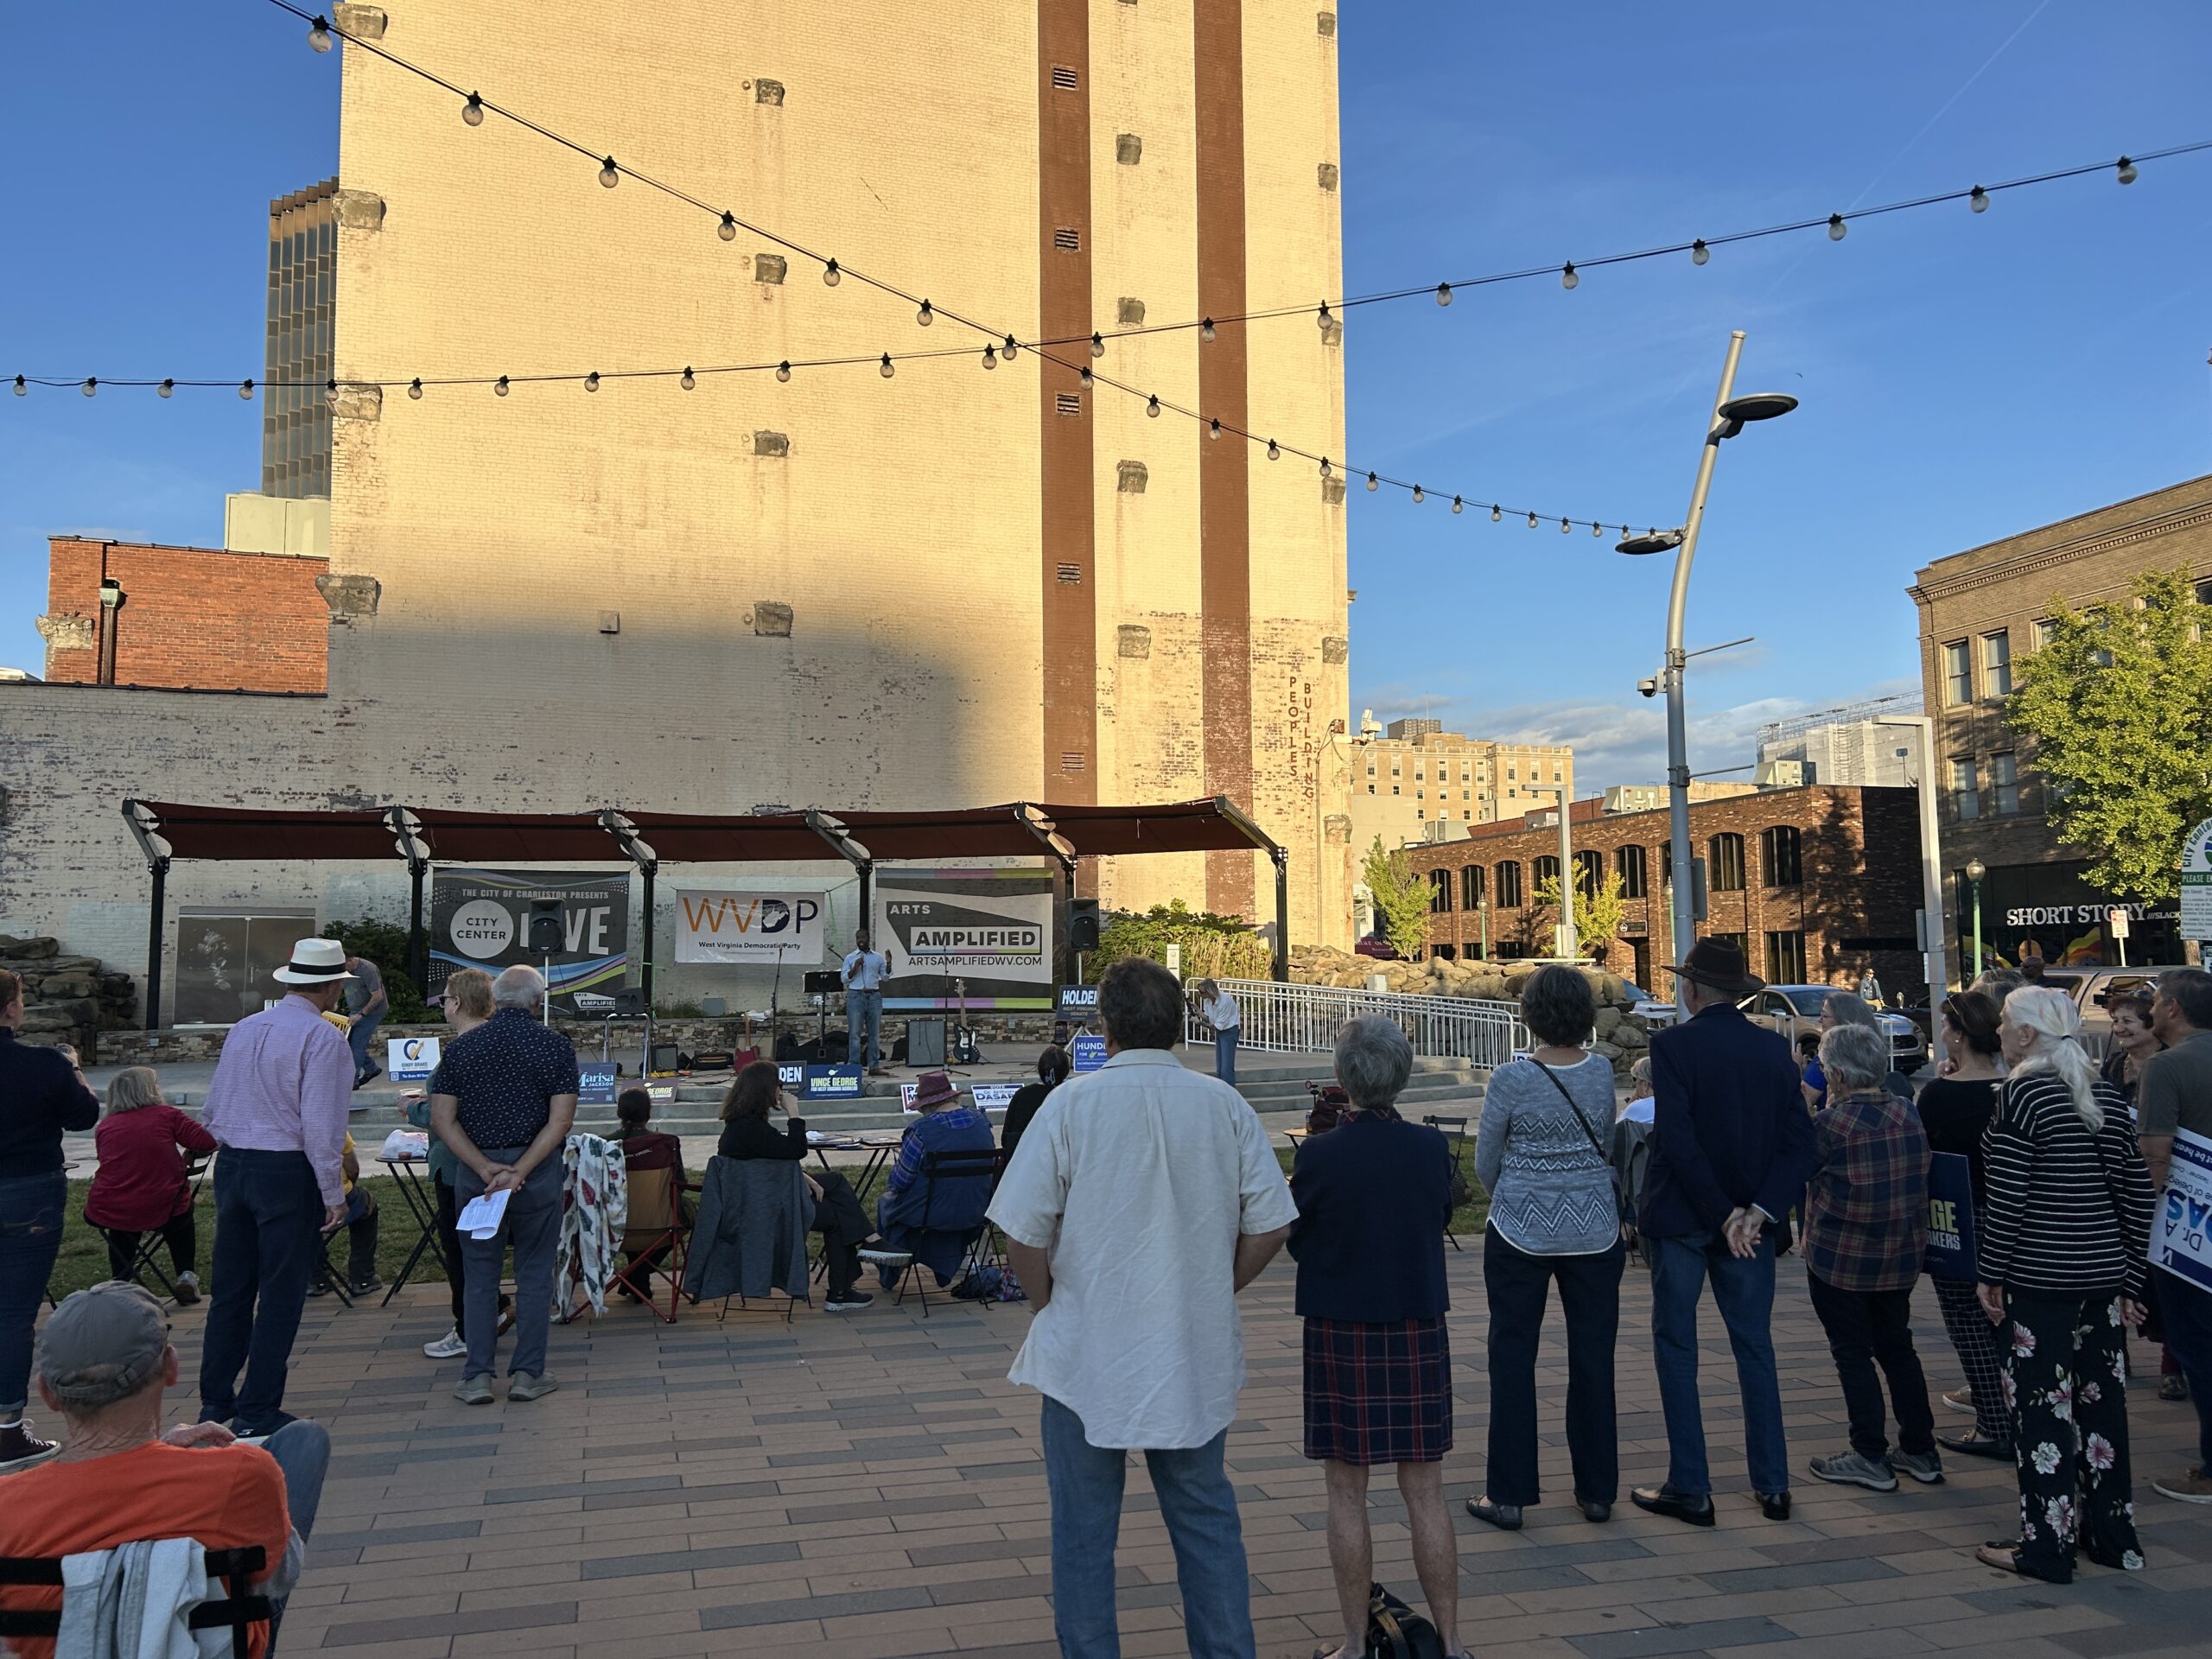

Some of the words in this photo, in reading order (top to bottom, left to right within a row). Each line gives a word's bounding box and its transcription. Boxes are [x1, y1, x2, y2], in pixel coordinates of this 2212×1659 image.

[1288, 677, 1299, 777] PEOPLES
[1305, 683, 1314, 798] BUILDING
[2183, 847, 2195, 868] City
[2189, 819, 2212, 846] Cente
[2182, 874, 2203, 883] PLEASE
[461, 888, 479, 897] THE
[480, 889, 501, 898] CITY
[503, 889, 512, 898] OF
[516, 890, 567, 899] CHARLESTON
[570, 891, 609, 899] PRESENTS
[683, 897, 818, 934] WVDP
[890, 905, 931, 915] ARTS
[2006, 906, 2074, 926] SHORT
[466, 918, 499, 927] CITY
[456, 930, 506, 940] CENTER
[519, 906, 611, 956] LVE
[915, 931, 1036, 946] AMPLIFIED
[909, 956, 1042, 966] ARTSAMPLIFIEDWV.COM
[579, 1071, 614, 1087] Marisa
[779, 1066, 803, 1083] DEN
[810, 1077, 831, 1087] VINCE
[832, 1077, 858, 1086] GEORGE
[976, 1092, 1014, 1101] DASAR
[2173, 1141, 2195, 1158] hear
[1926, 1230, 1961, 1250] RKERS
